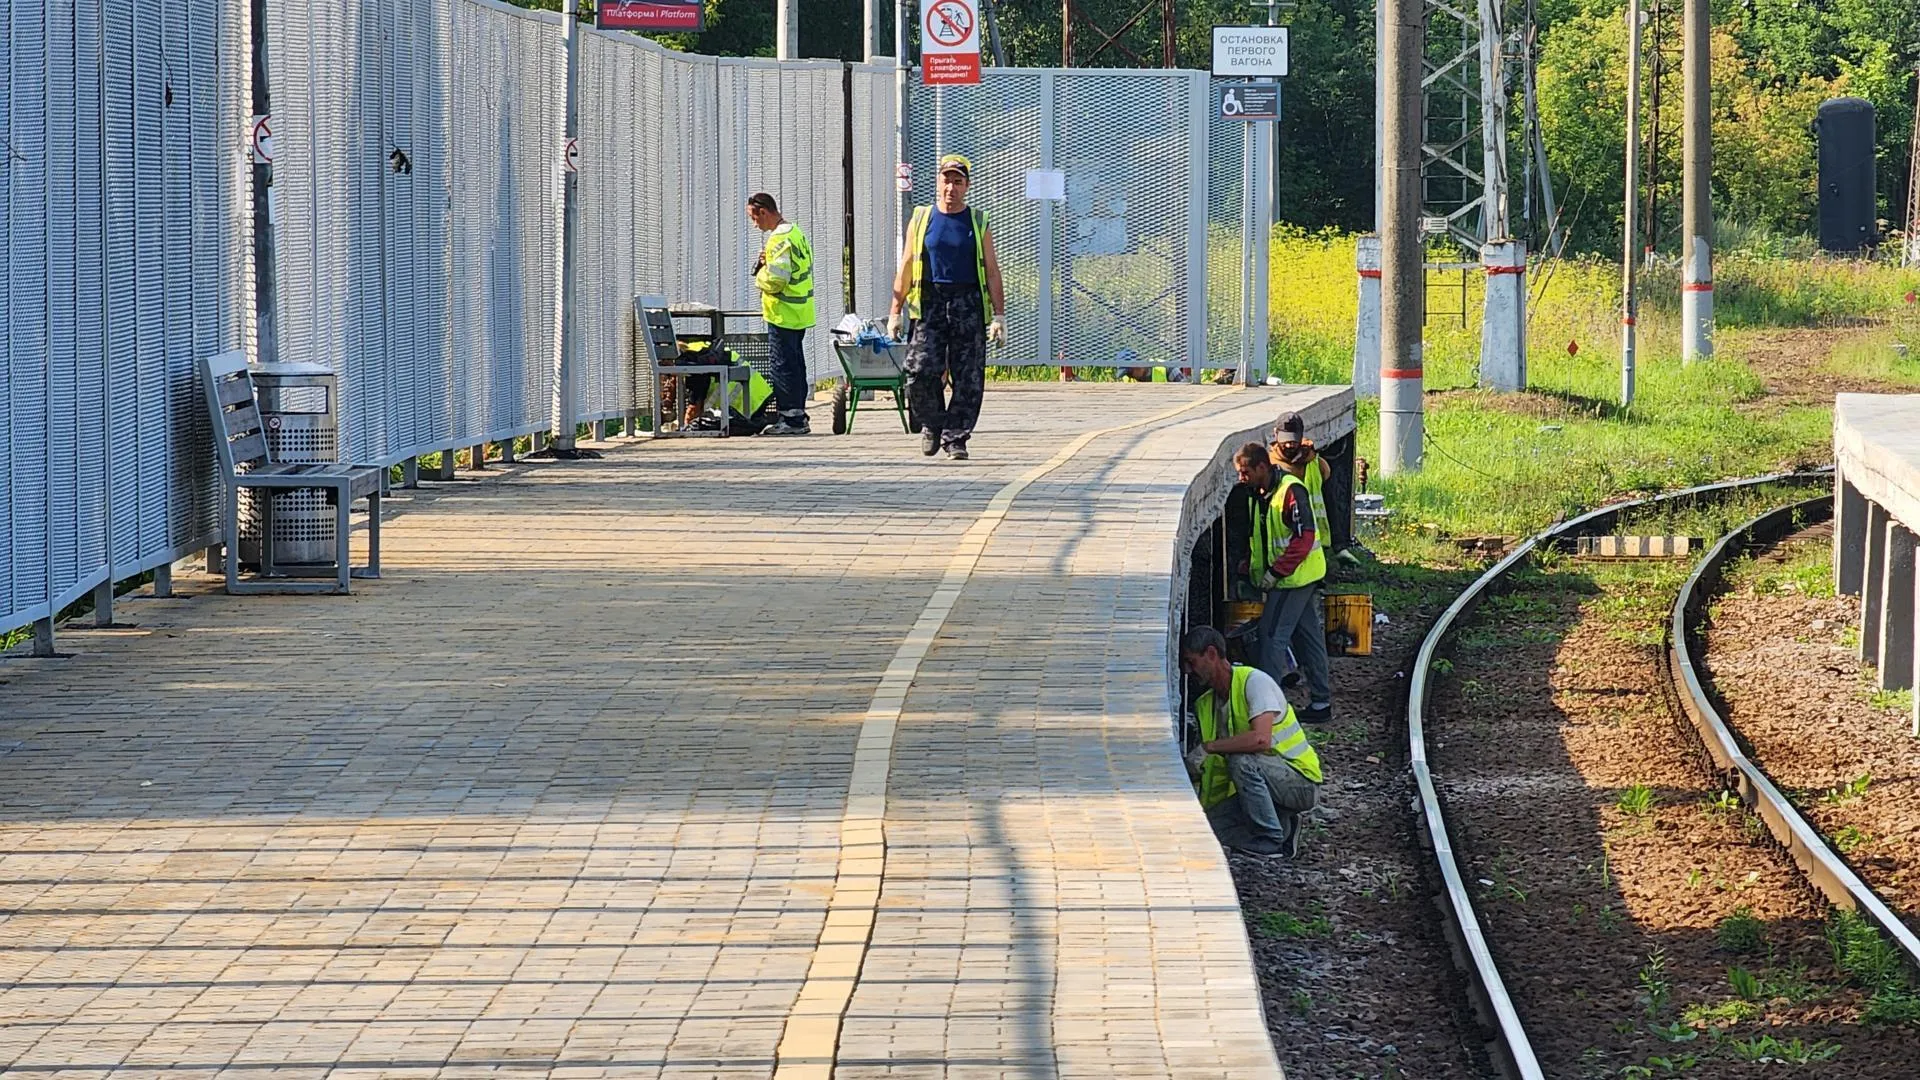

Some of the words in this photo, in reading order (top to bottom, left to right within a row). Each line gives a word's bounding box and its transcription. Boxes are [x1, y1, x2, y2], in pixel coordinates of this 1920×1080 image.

[606, 9, 655, 19] Платформа
[660, 9, 696, 19] Platform
[1220, 36, 1284, 44] ОСТАНОВКА
[1227, 46, 1276, 56] ПЕРВОГО
[1230, 58, 1272, 66] ВАГОНА
[930, 71, 968, 79] запрещено!
